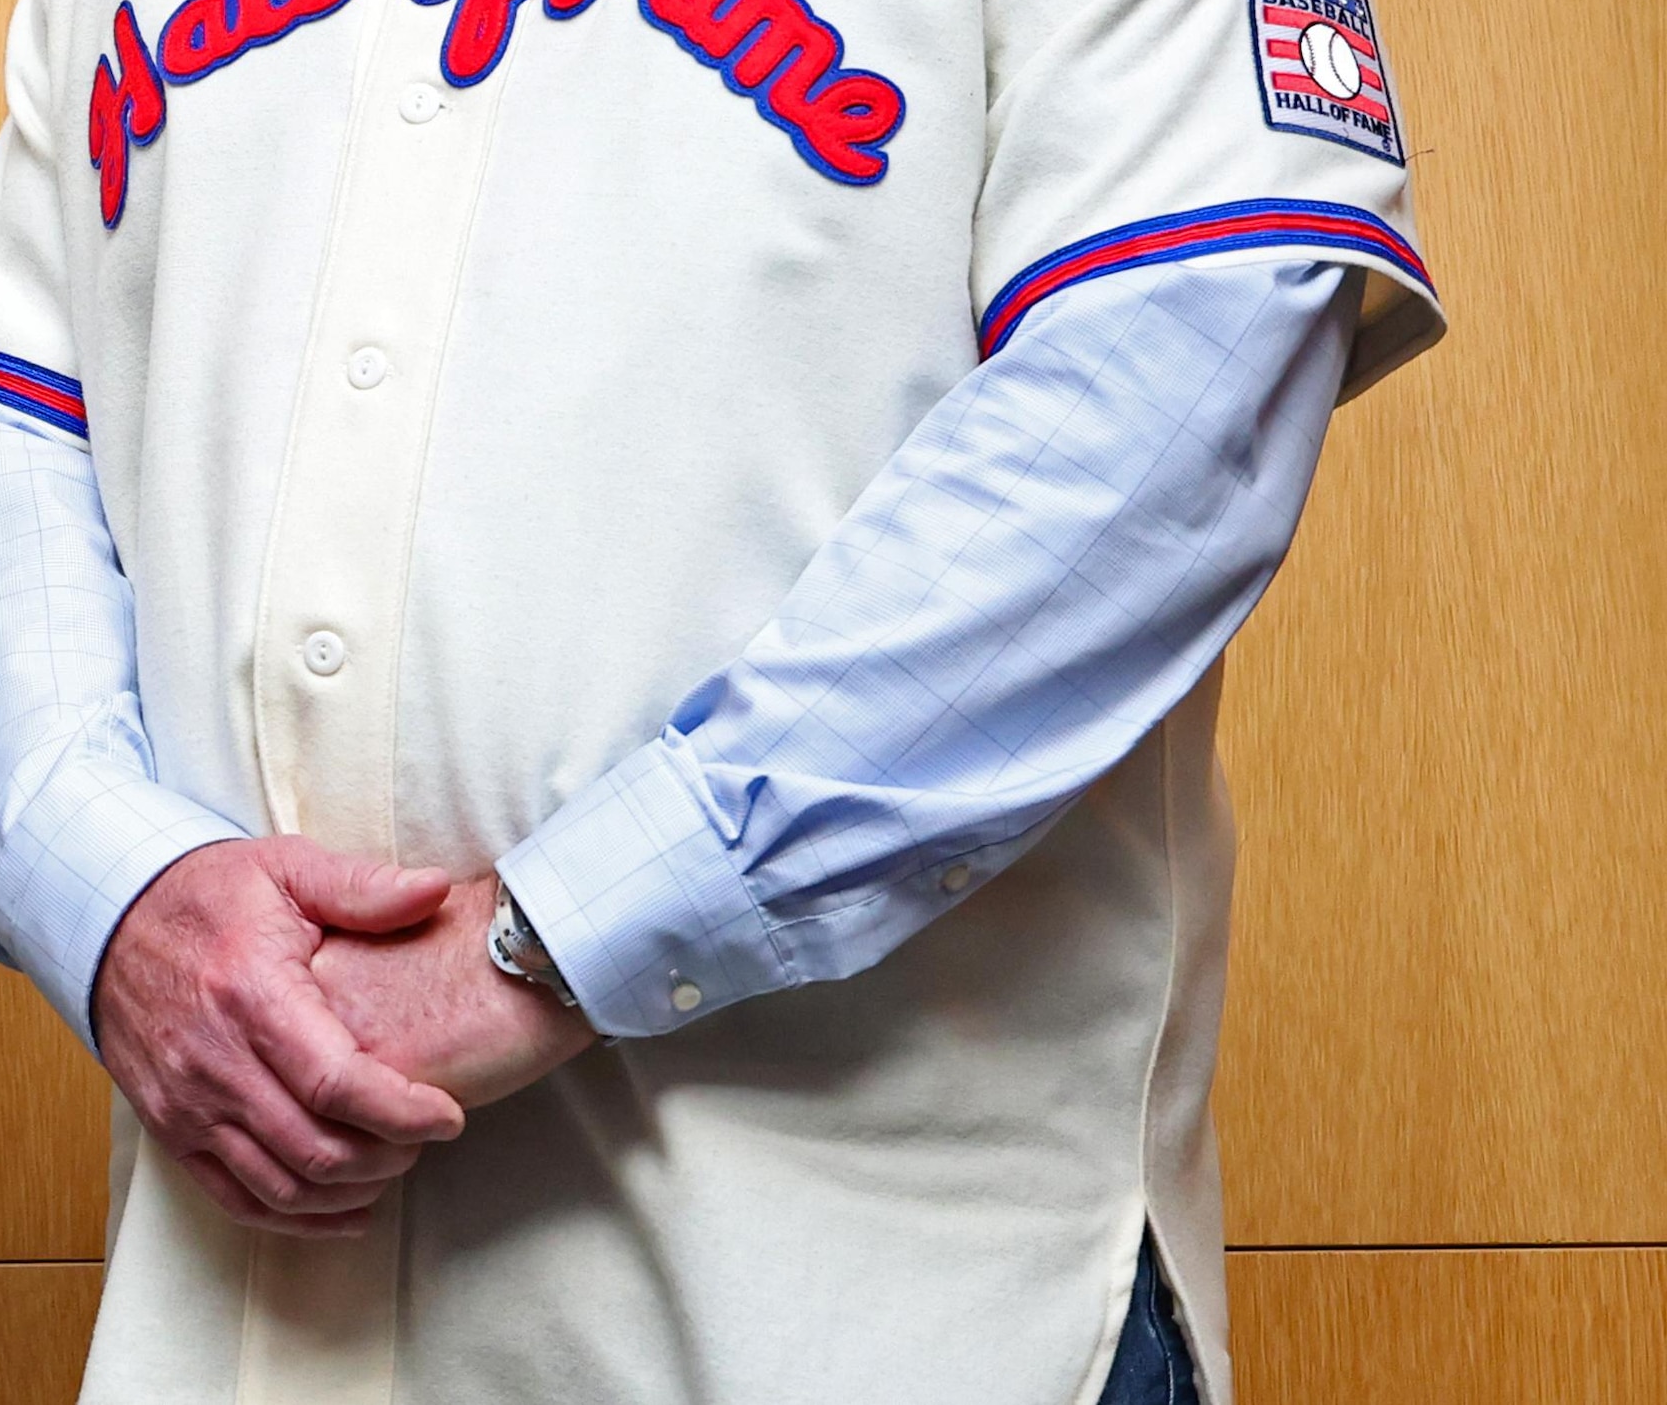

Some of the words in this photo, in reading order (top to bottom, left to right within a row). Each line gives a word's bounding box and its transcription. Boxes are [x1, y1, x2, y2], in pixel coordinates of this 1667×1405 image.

[1274, 92, 1330, 117] HALL
[1330, 104, 1352, 122] OF
[1351, 112, 1393, 143] FAME
